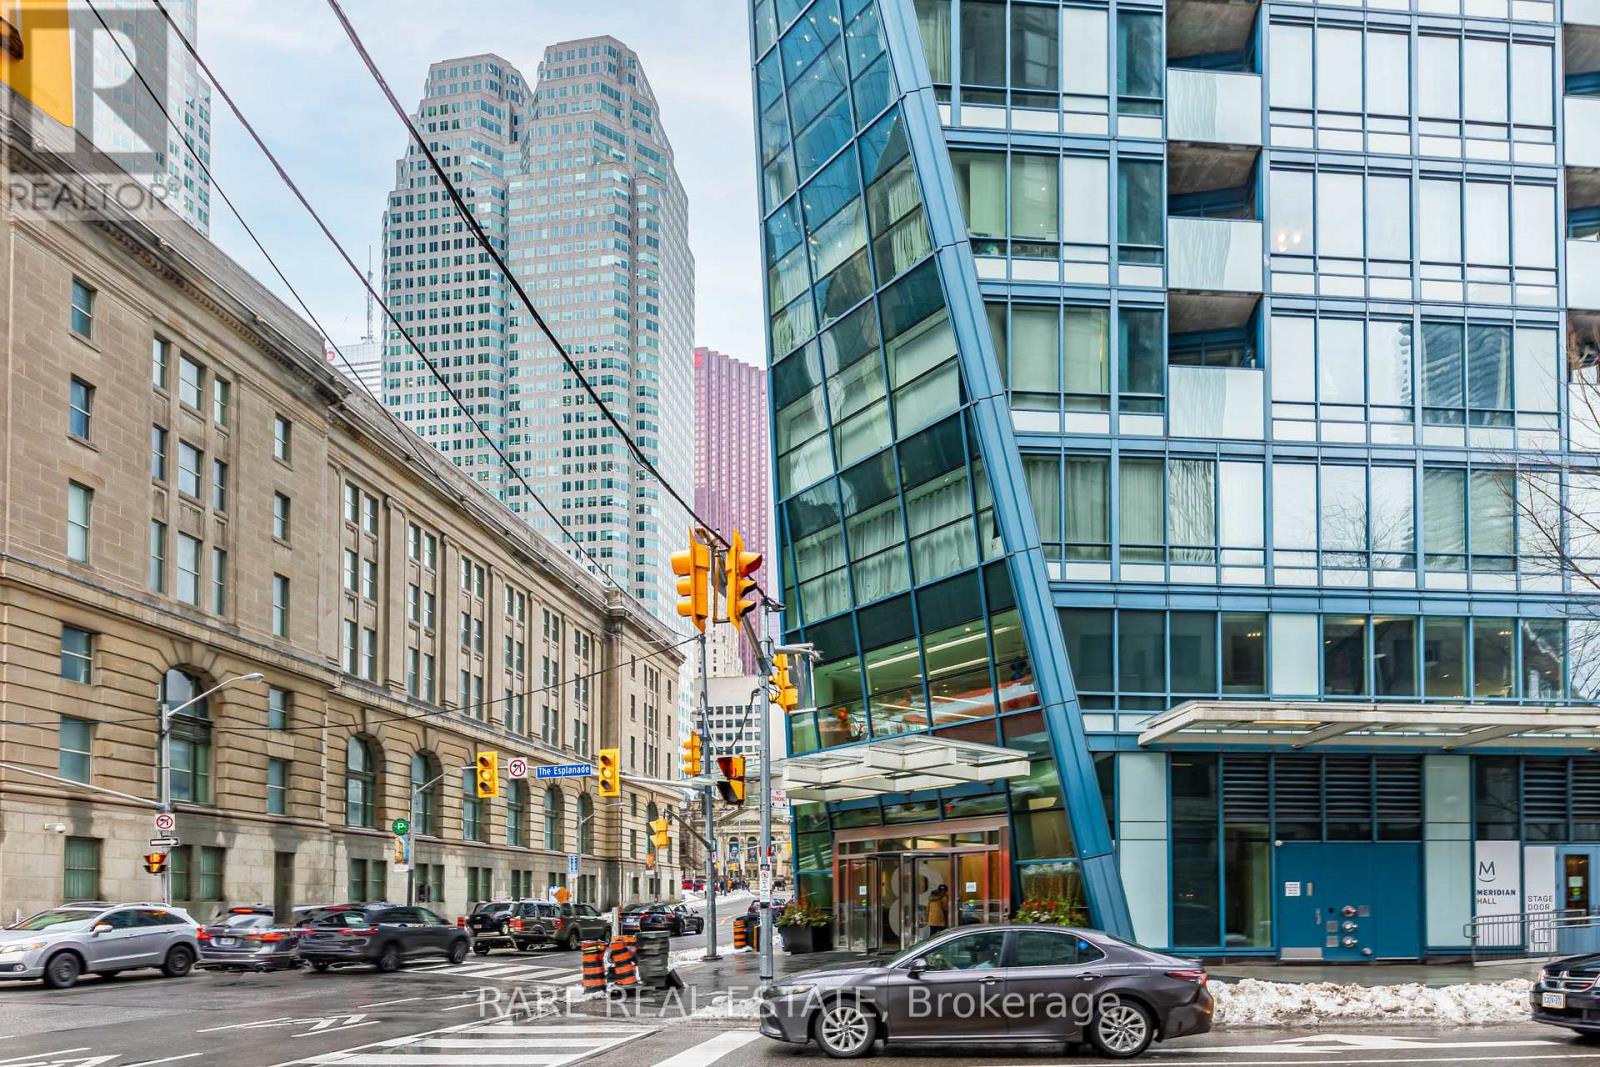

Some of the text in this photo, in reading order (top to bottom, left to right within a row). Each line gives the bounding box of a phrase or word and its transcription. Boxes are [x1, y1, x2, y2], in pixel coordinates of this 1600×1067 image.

[538, 765, 590, 776] The Esplanade
[1479, 861, 1495, 876] M
[1527, 895, 1553, 903] STAGE
